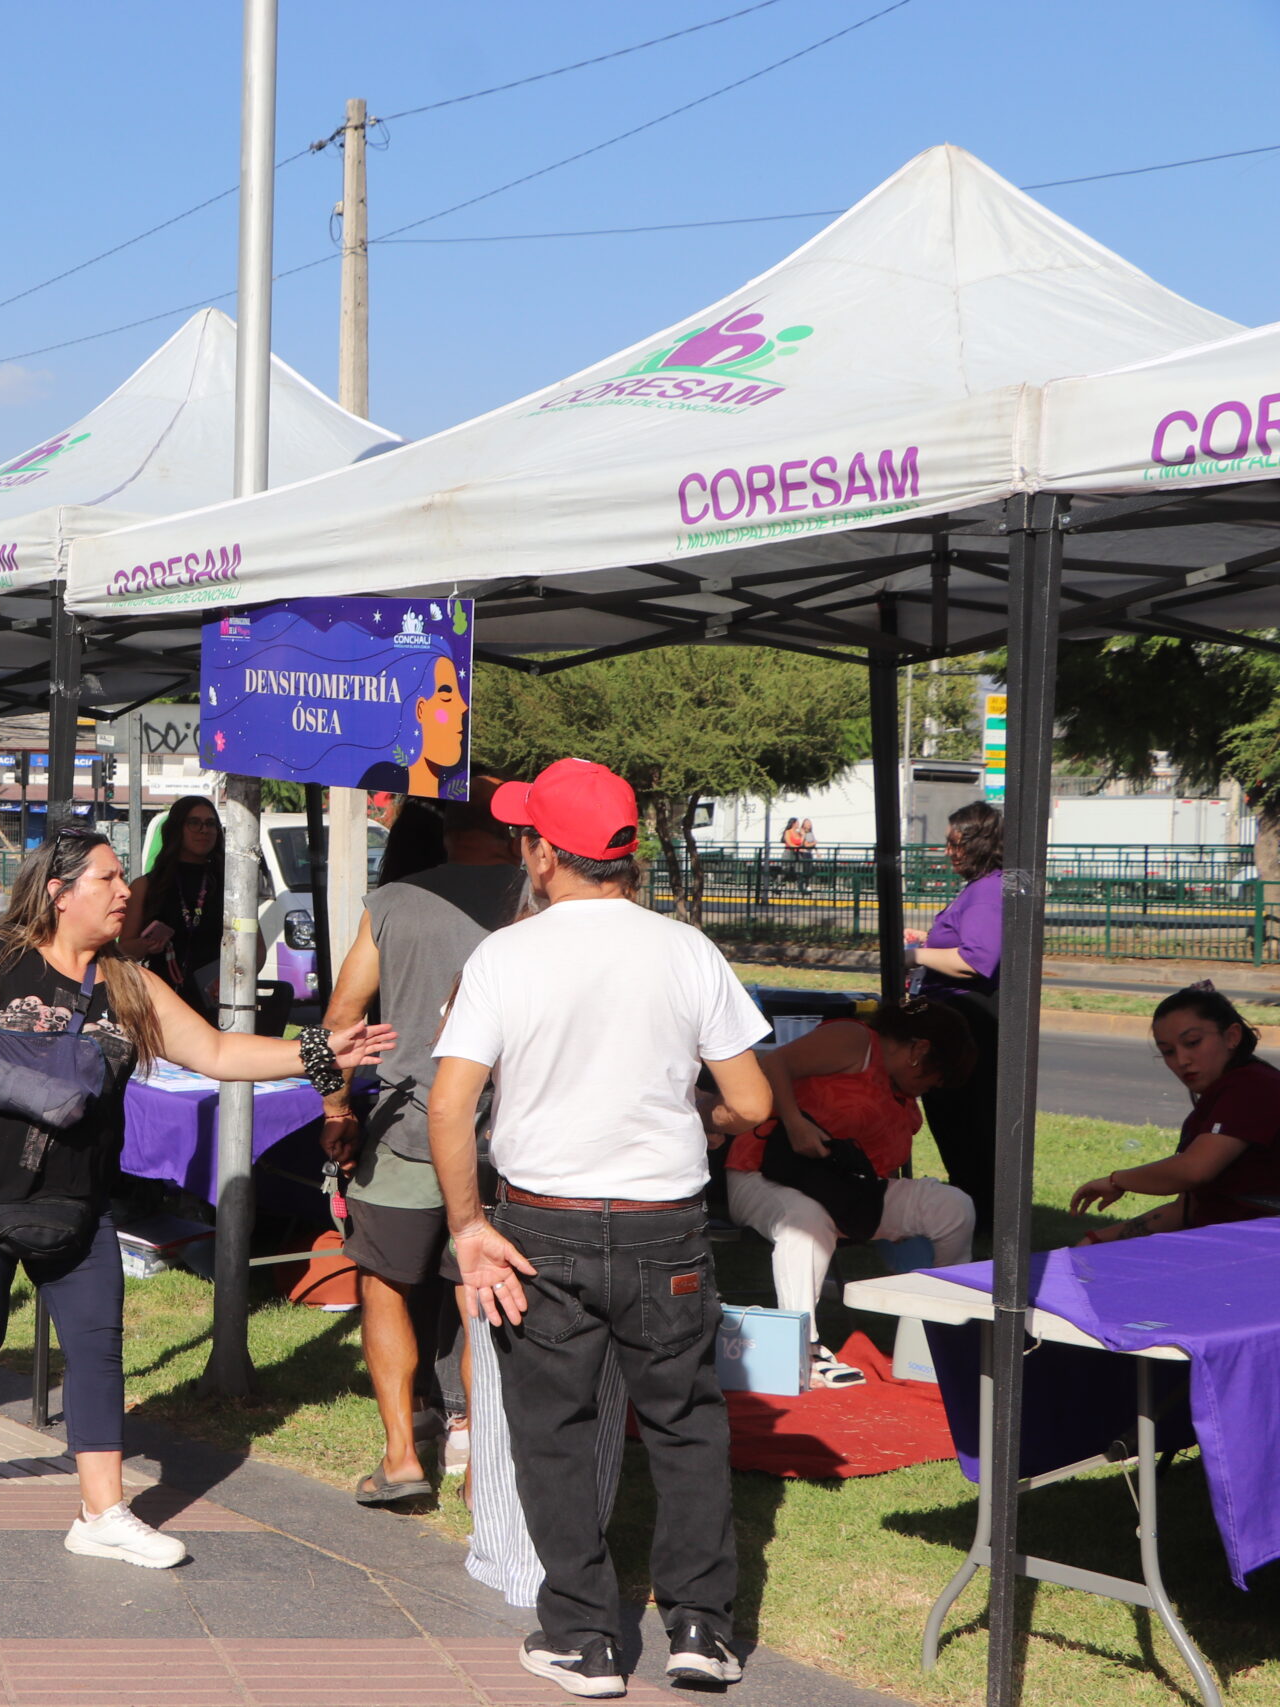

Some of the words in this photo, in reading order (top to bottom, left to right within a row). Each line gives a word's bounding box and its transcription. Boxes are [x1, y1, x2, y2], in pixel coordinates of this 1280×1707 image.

[539, 376, 787, 409] CORESAM
[677, 445, 920, 525] CORESAM
[686, 518, 805, 550] MUNICIPALIDAD
[807, 514, 829, 531] DE
[106, 542, 242, 597] CORESAM
[244, 668, 403, 704] DENSITOMETRÍA
[291, 700, 342, 735] ÓSEA
